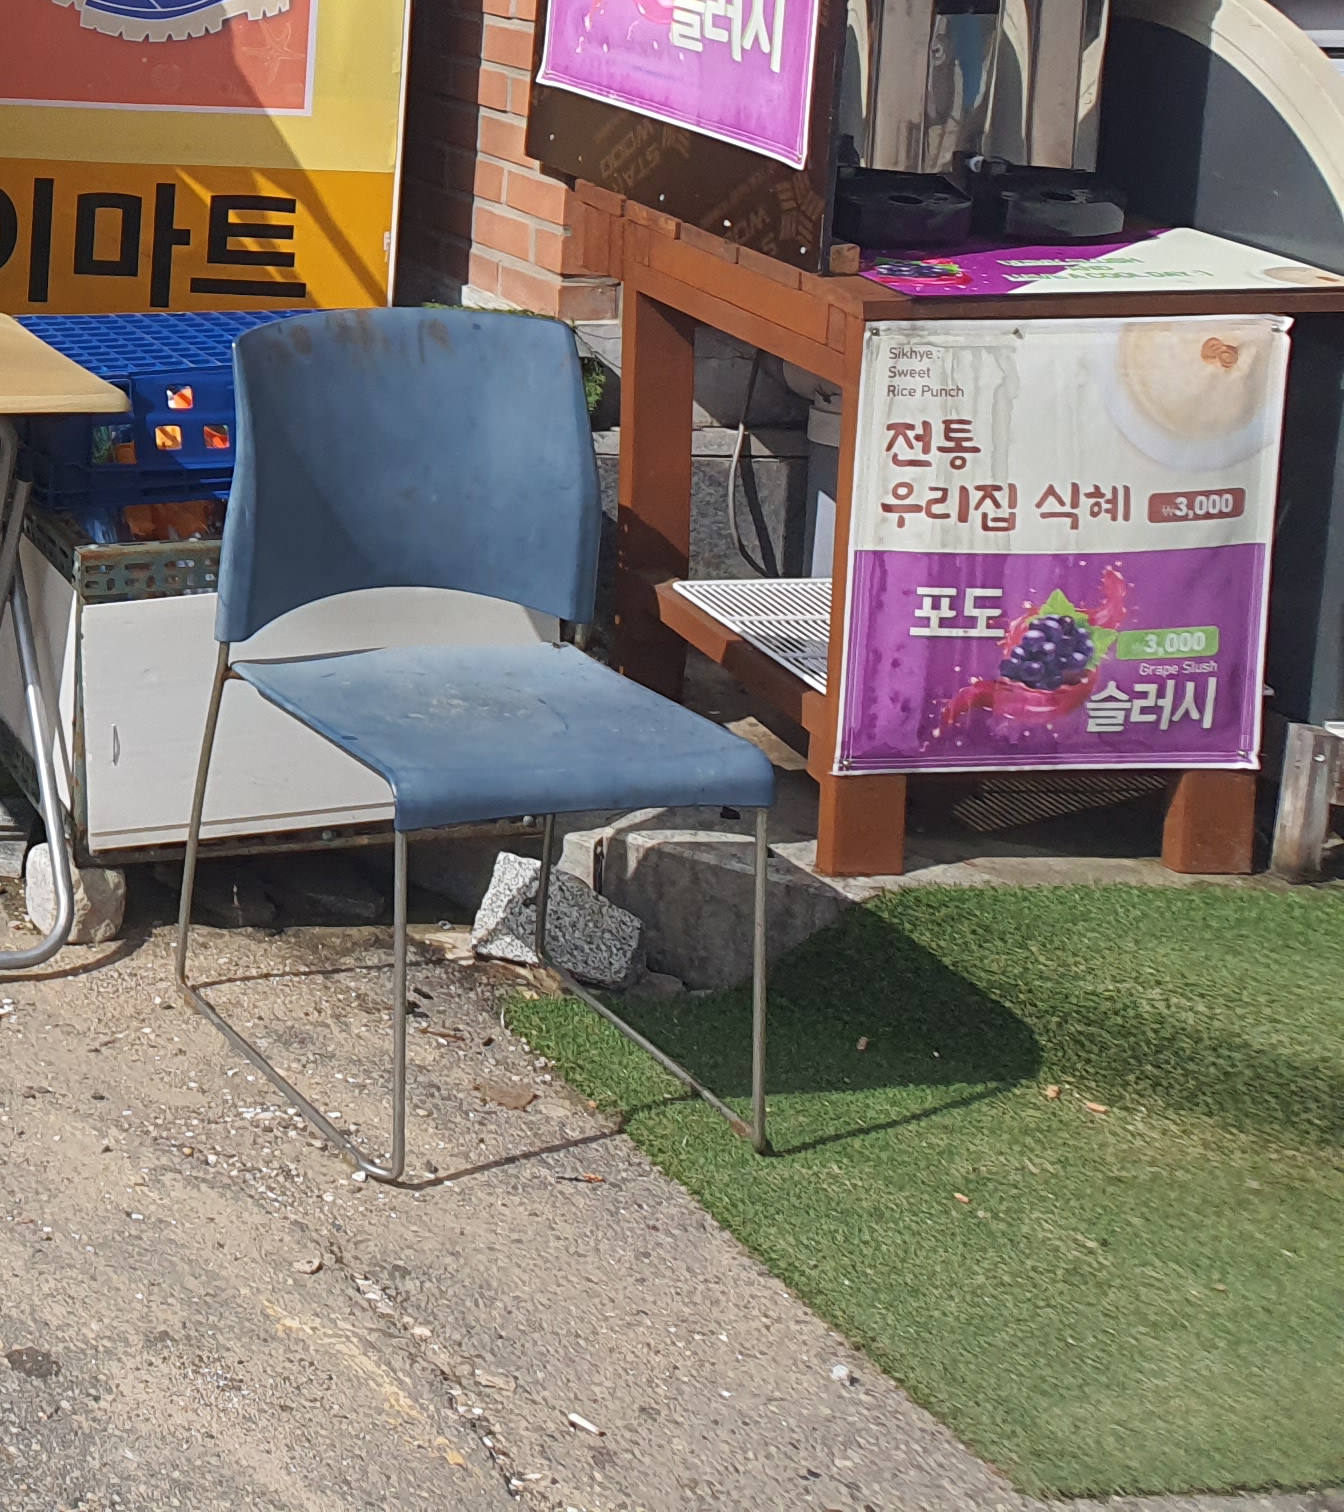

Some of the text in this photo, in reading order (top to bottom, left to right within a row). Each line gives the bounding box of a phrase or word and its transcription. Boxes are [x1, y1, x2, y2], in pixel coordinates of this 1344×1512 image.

[888, 347, 934, 363] Sikhye
[888, 366, 932, 380] Sweet
[887, 384, 965, 399] Rice Punch
[885, 418, 981, 470] 전통
[880, 481, 1018, 532] 우리집
[1034, 482, 1131, 531] 식혜
[909, 587, 1005, 637] 포도
[1139, 660, 1218, 677] Grape Slush
[1086, 676, 1217, 733] 슬러시
